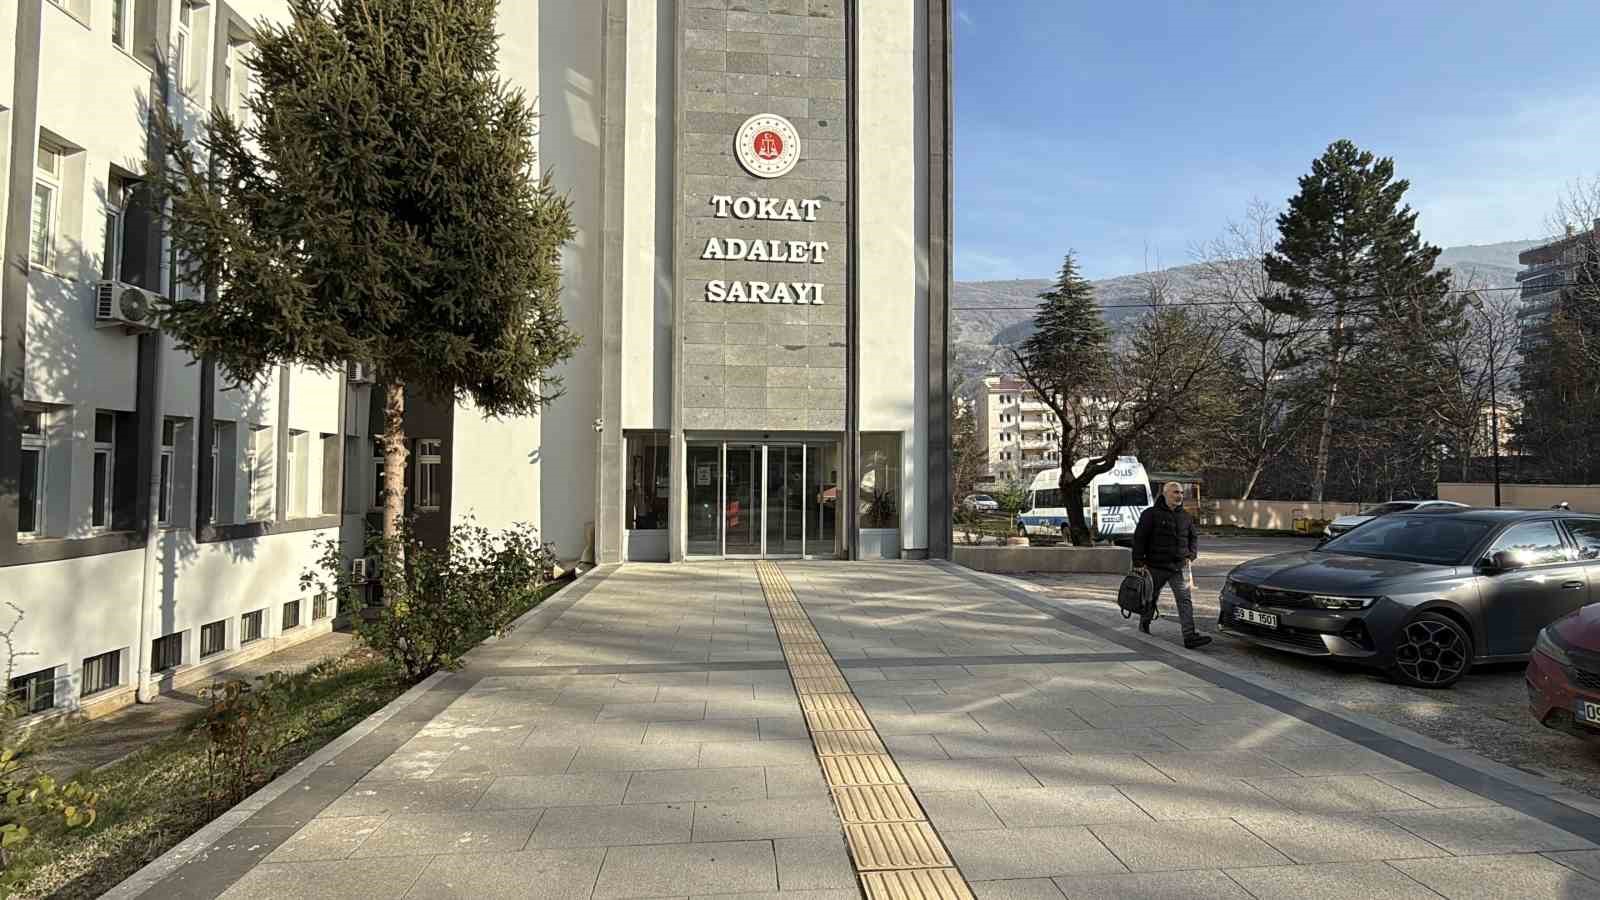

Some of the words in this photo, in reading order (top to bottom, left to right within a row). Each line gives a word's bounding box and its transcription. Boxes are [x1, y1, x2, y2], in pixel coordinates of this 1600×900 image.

[711, 194, 821, 221] TOKAT
[702, 237, 829, 263] ADALET
[706, 279, 825, 304] SARAYI
[1258, 613, 1277, 625] 1501
